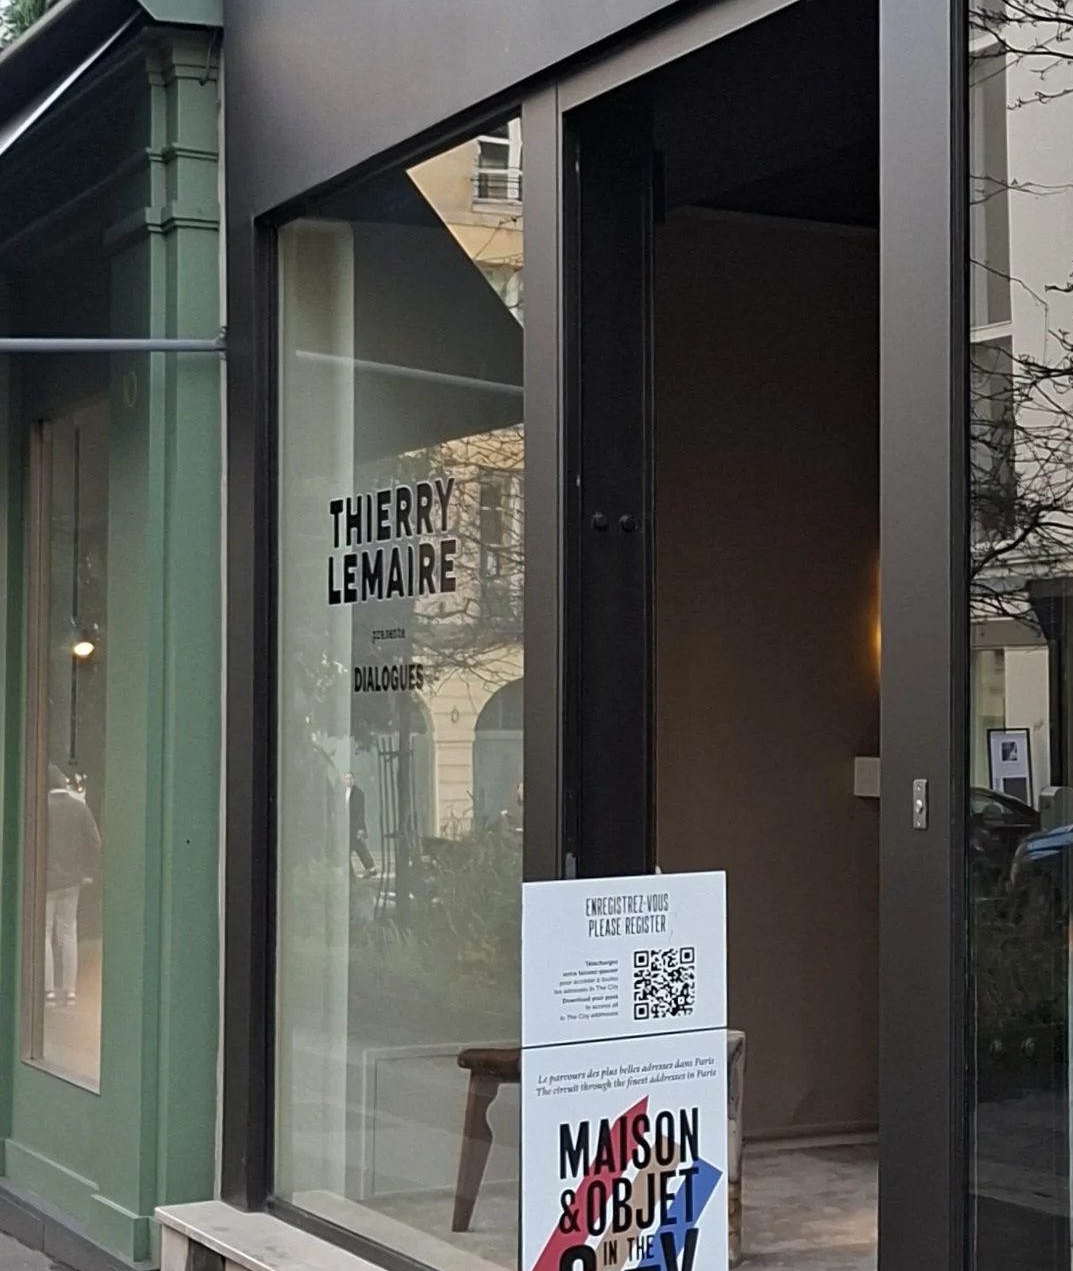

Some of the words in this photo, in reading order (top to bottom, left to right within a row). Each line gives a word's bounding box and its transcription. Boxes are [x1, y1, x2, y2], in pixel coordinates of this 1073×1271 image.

[329, 477, 455, 548] THIERRY
[327, 538, 457, 606] LEMAIRE
[353, 663, 424, 693] DIALOGUES
[585, 893, 669, 917] ENREGISTREZ-VOUS
[588, 918, 621, 937] PLEASE
[625, 914, 666, 935] REGISTER
[535, 1085, 551, 1098] The
[696, 1067, 717, 1079] Paris
[559, 1106, 700, 1180] MAISON
[602, 1239, 618, 1266] IN
[626, 1234, 655, 1262] THE
